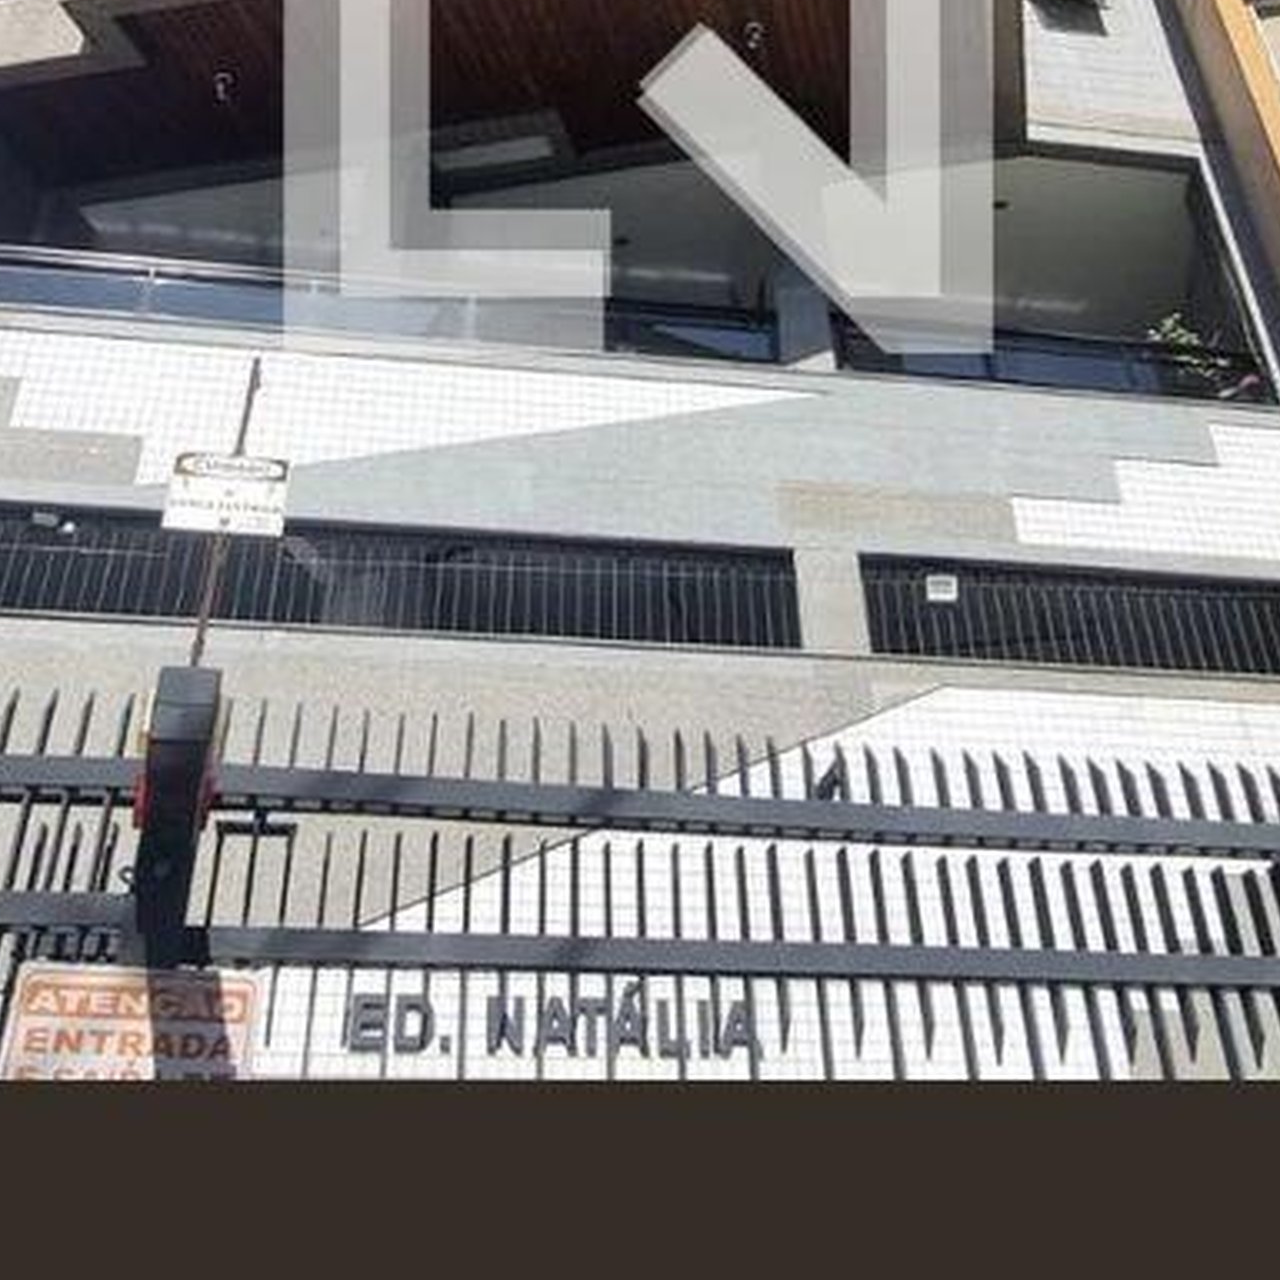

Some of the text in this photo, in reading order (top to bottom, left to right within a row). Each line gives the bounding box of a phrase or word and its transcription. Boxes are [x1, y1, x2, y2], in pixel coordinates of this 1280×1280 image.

[23, 1027, 234, 1060] ENTRADA
[347, 981, 762, 1058] ED. NATÁLIA
